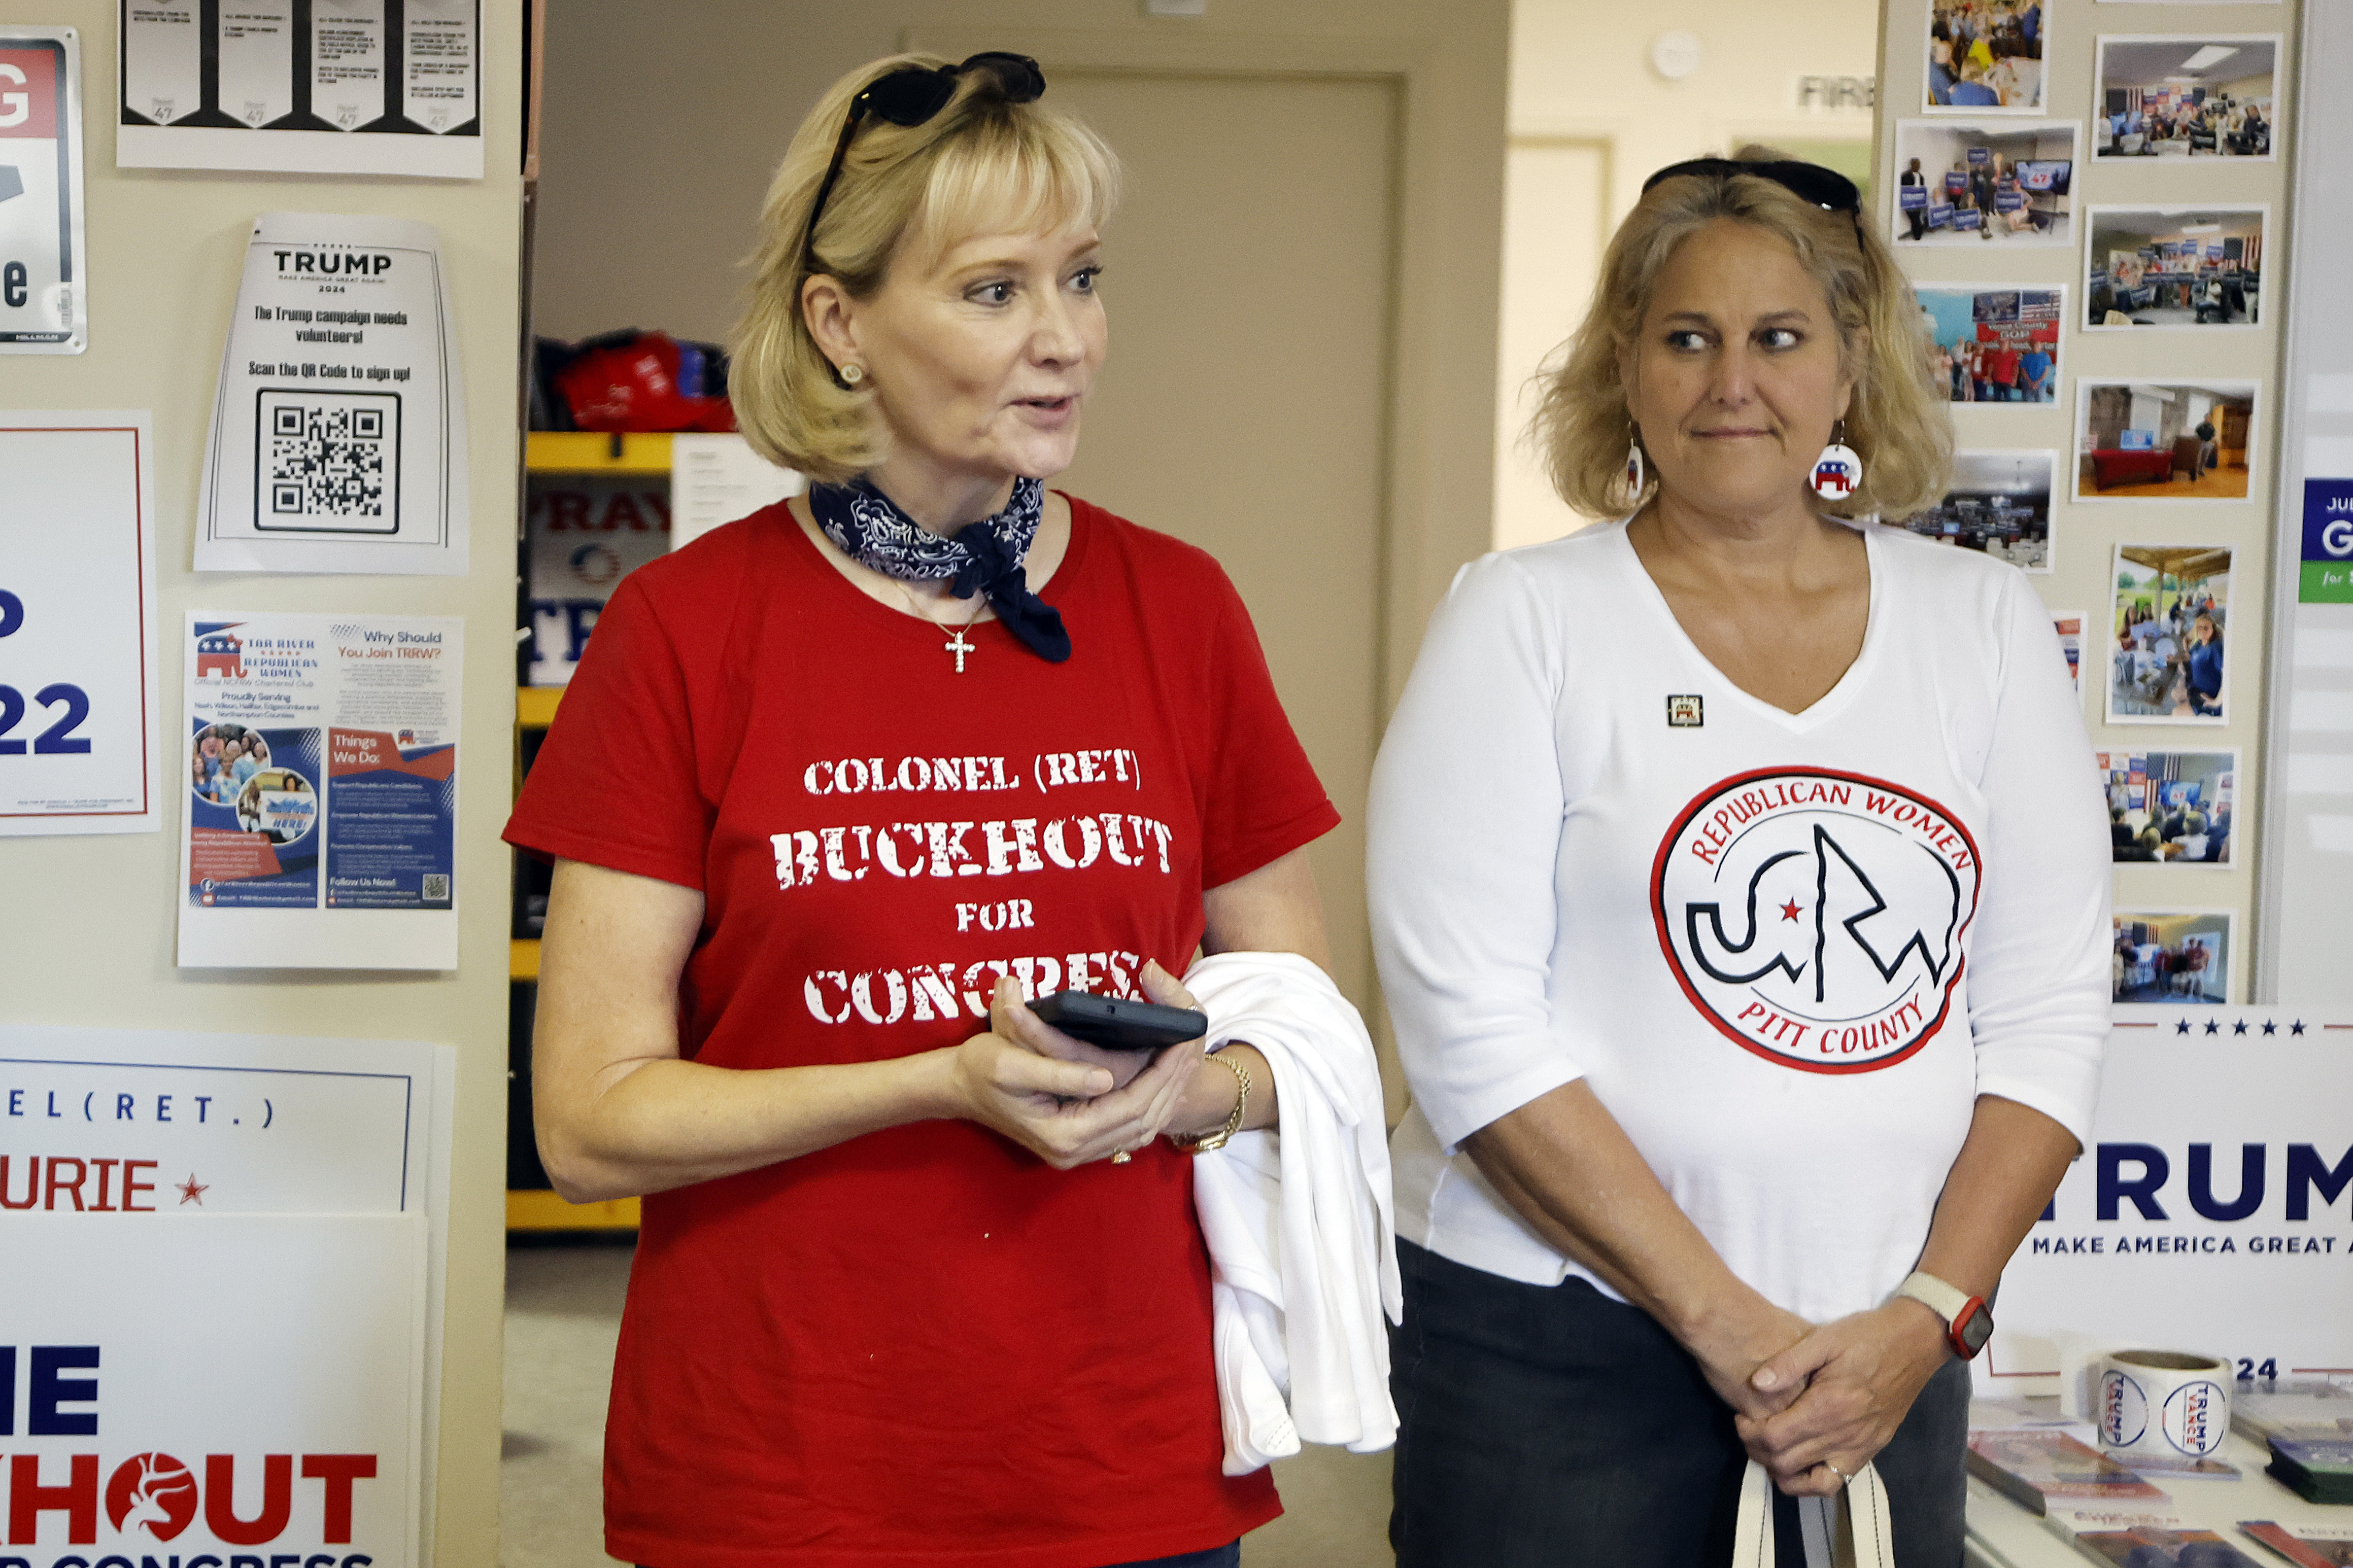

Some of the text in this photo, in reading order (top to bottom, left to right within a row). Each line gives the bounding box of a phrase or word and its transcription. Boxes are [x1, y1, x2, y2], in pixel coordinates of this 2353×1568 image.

[274, 250, 392, 275] TRUMP
[318, 285, 346, 293] 2024
[255, 305, 407, 325] The Trump campaign needs
[296, 328, 363, 344] volunteers!
[249, 361, 411, 382] Scan the QR Code to sign up!
[2326, 497, 2353, 512] JU
[364, 631, 441, 645] Why Should
[338, 646, 363, 658] You
[366, 647, 393, 658] Join
[221, 691, 256, 702] Proudly
[333, 734, 377, 751] Things
[333, 751, 381, 764] We Do:
[803, 748, 1141, 795] COLONEL (RET)
[1691, 782, 1972, 871] REPUBLICAN WOMEN
[769, 813, 1173, 891] BUCKHOUT
[955, 898, 1035, 932] FOR
[803, 950, 1144, 1025] CONGRES
[1737, 992, 1923, 1054] PITT COUNTY
[2038, 1142, 2353, 1222] RUM
[2033, 1236, 2337, 1256] MAKE AMERICA GREAT
[2112, 1376, 2125, 1444] TRUMP
[2186, 1394, 2198, 1445] VANCE
[2196, 1383, 2209, 1452] TRUMP
[0, 1452, 377, 1546] HOUT
